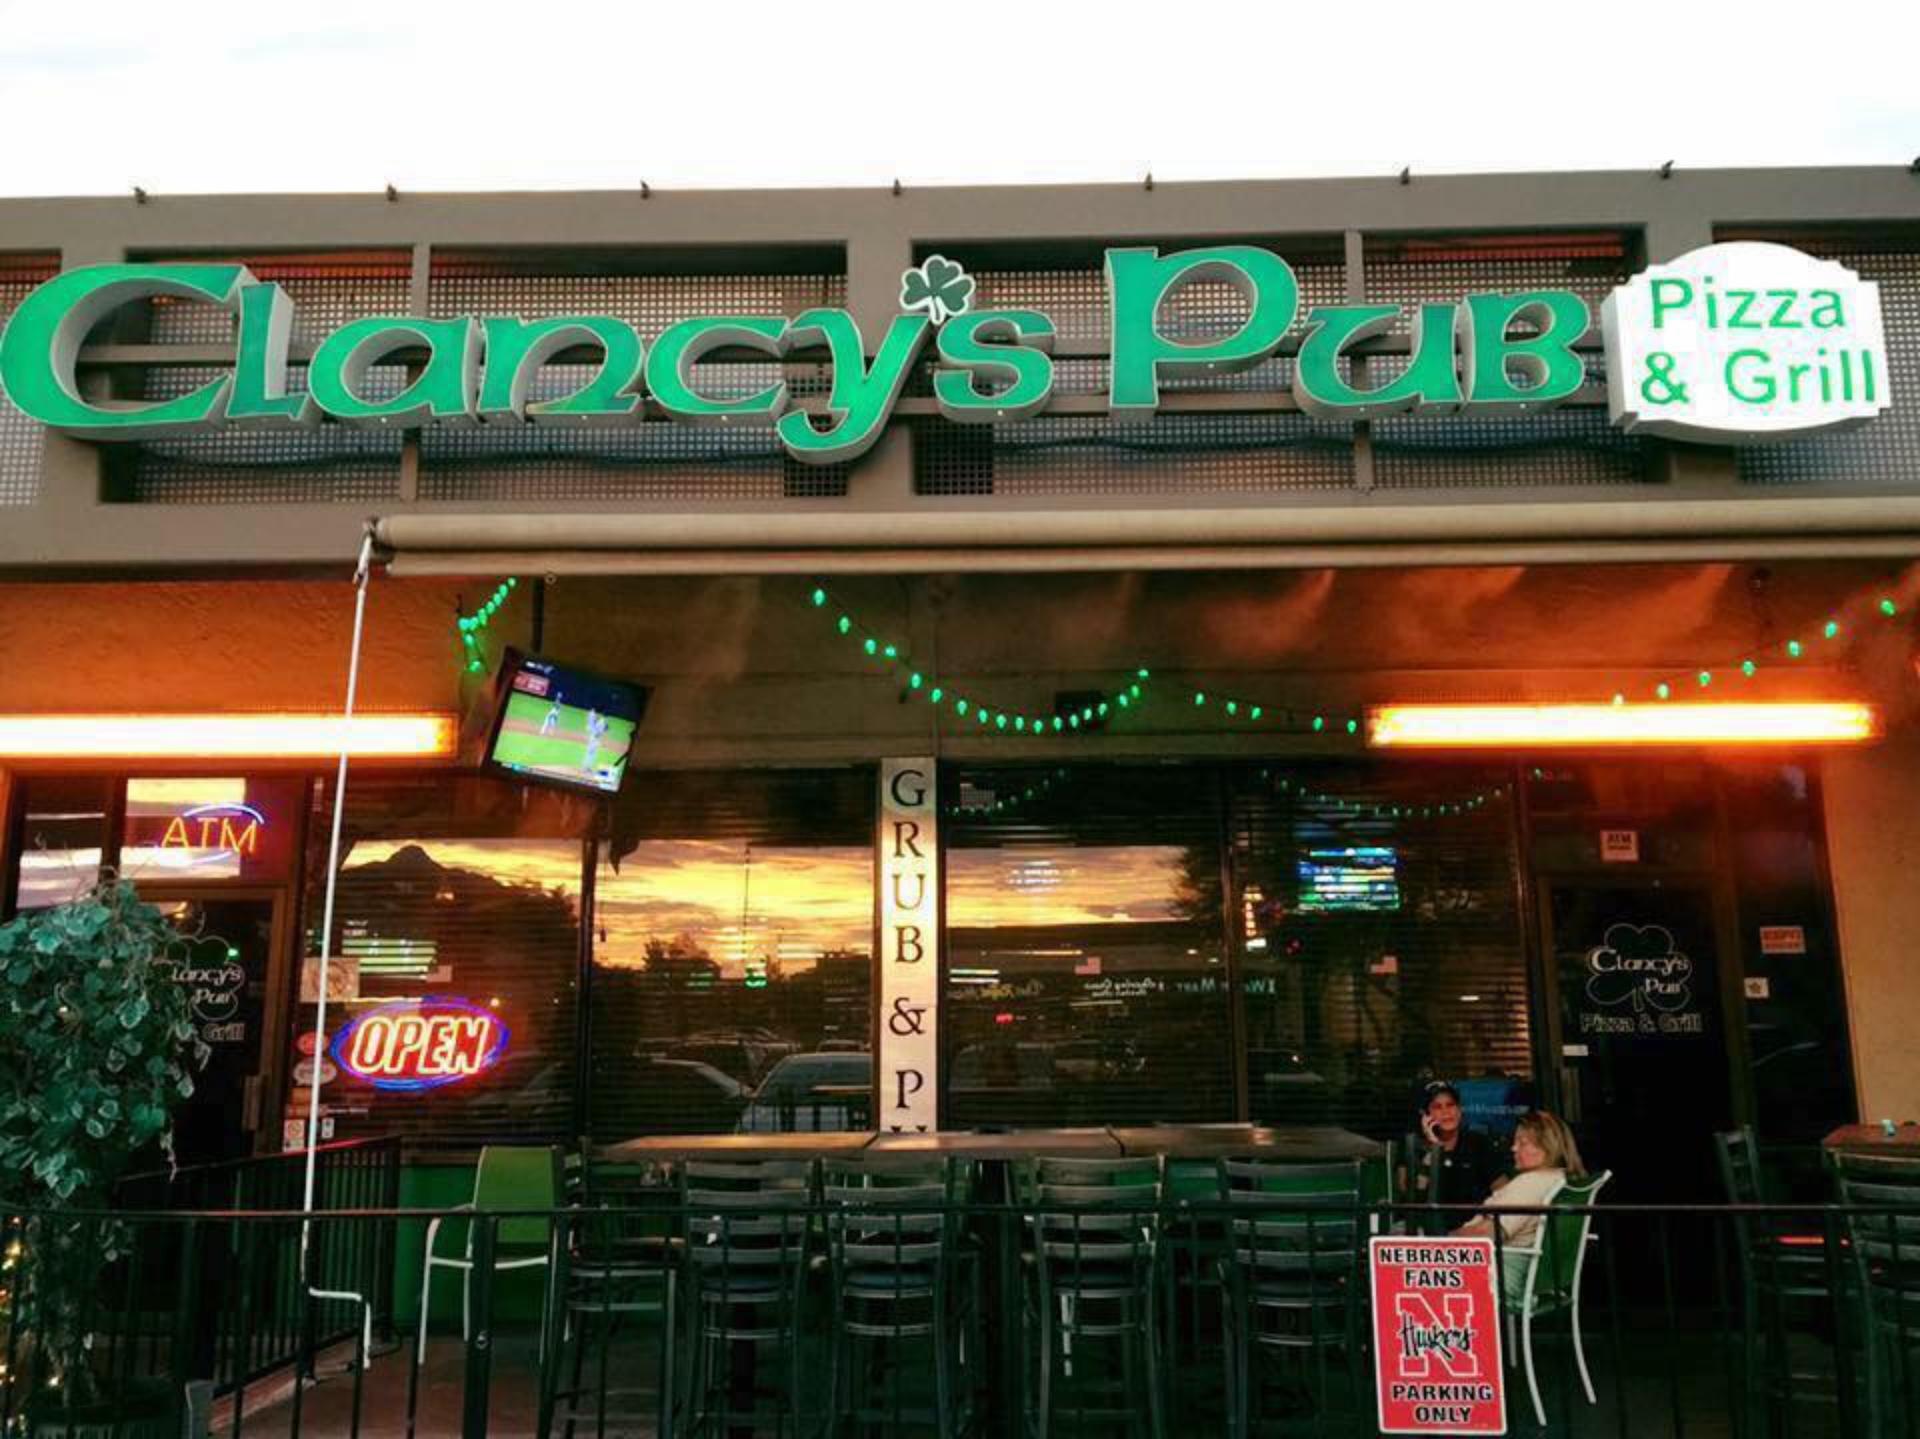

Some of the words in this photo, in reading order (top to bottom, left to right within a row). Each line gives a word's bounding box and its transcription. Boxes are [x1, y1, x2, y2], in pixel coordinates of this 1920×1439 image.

[1649, 276, 1846, 331] Pizza
[1639, 350, 1691, 405] &
[1723, 346, 1876, 407] Grill
[161, 815, 258, 852] ATM
[890, 769, 926, 964] GRUB
[888, 997, 926, 1036] &
[350, 1014, 491, 1075] OPEN
[1379, 1248, 1486, 1265] NEBRASKA
[1404, 1269, 1463, 1288] FANS
[1391, 1384, 1494, 1402] PARKING
[1414, 1406, 1472, 1423] ONLY
